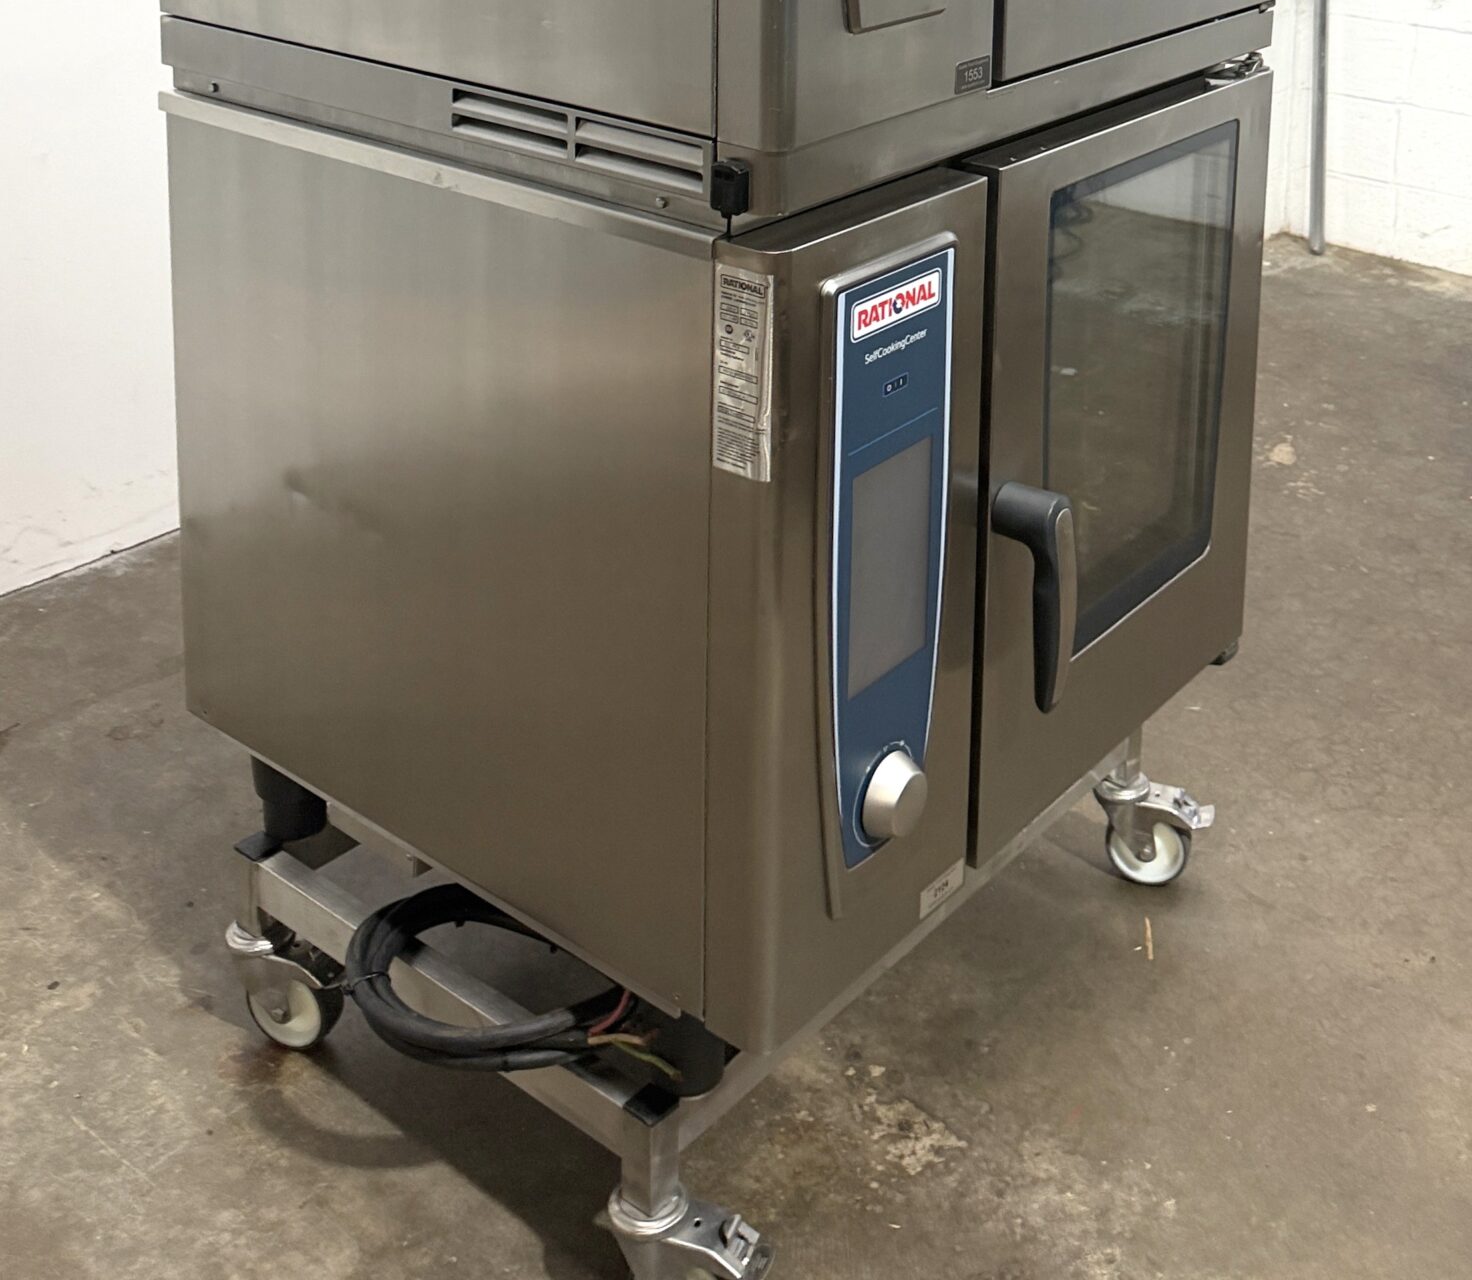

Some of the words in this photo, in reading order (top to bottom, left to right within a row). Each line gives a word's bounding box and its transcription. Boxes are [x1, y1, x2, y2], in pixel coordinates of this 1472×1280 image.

[723, 277, 763, 296] RATIONAL
[857, 281, 936, 331] RATIONAL
[864, 328, 928, 365] SelfCookingCenter
